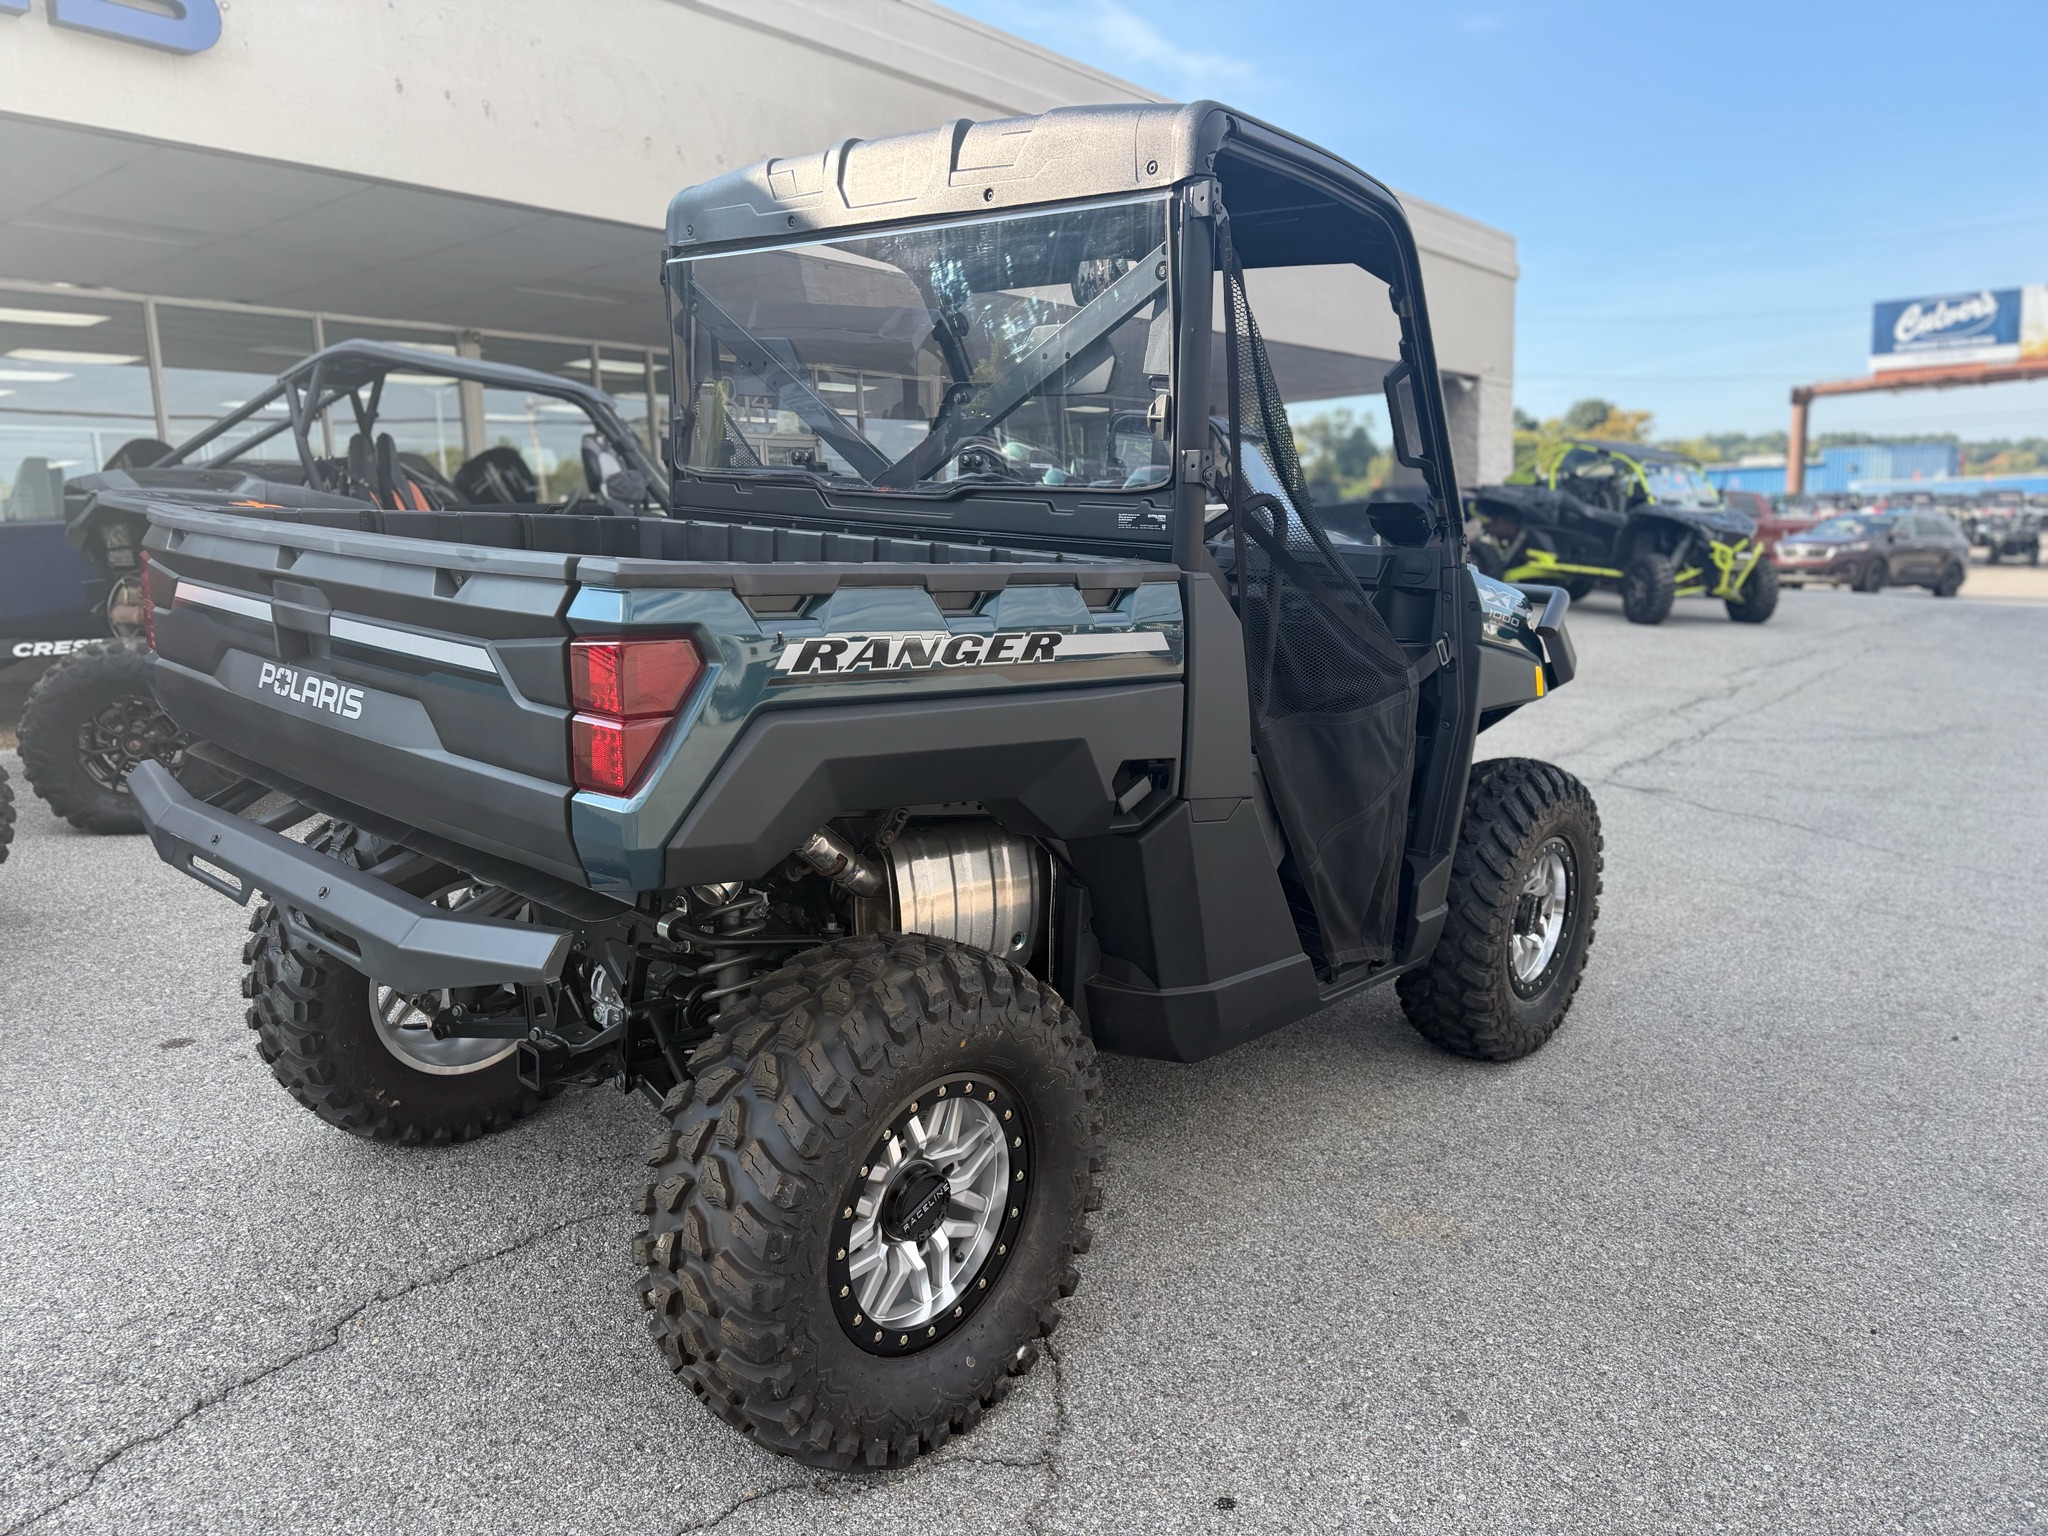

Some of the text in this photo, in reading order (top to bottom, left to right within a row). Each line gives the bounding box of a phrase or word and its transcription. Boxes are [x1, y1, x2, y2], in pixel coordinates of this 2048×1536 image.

[1489, 608, 1520, 627] 1000
[787, 631, 1063, 675] RANGER
[258, 661, 365, 720] POLARIS
[902, 1182, 950, 1233] RACELINE
